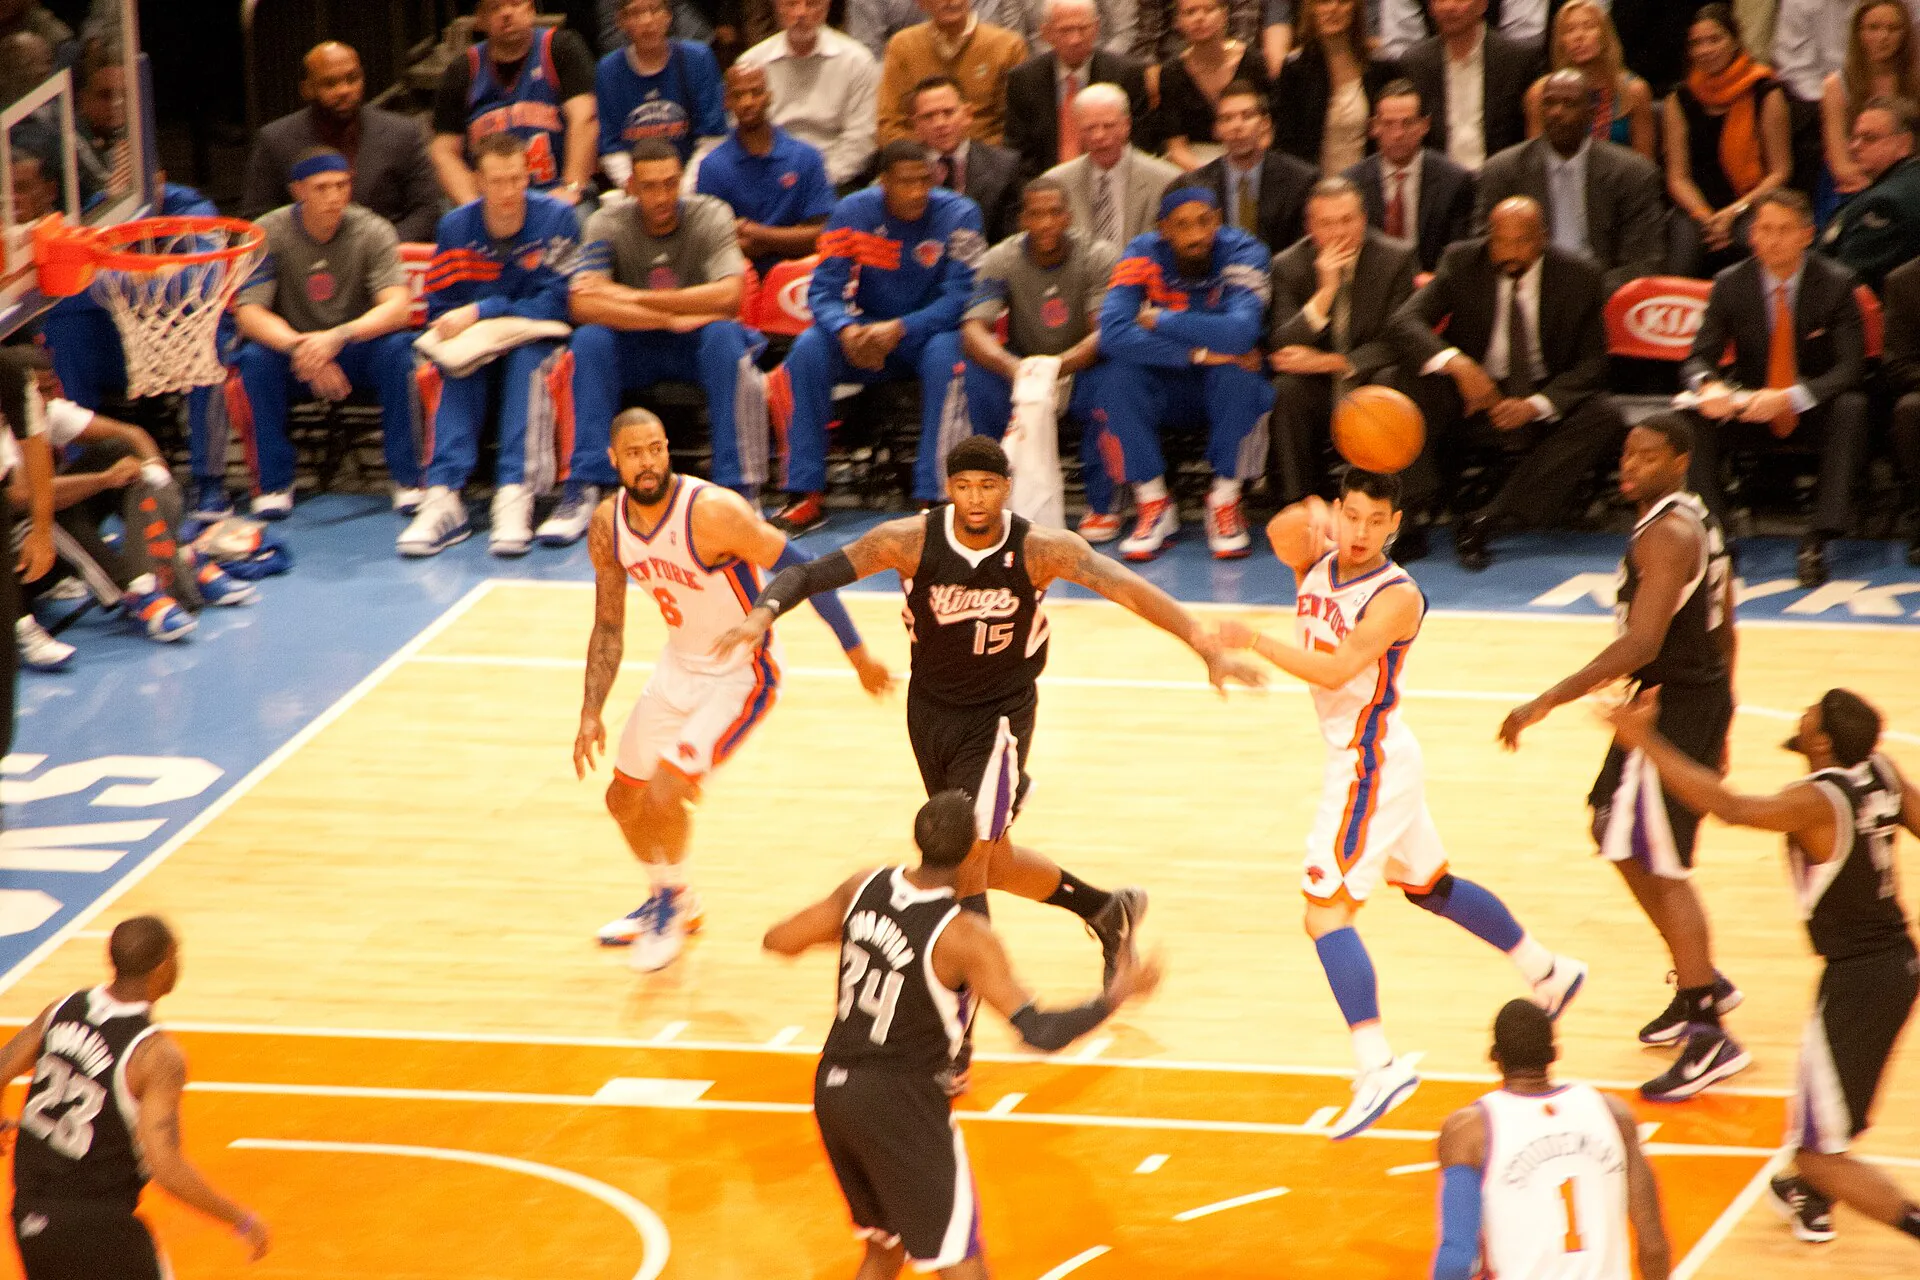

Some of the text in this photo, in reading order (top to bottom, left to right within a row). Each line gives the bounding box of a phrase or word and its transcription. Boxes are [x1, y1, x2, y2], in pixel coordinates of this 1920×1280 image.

[648, 557, 704, 591] YORK
[652, 587, 684, 630] 6
[929, 583, 1020, 625] Kings
[973, 620, 1015, 655] 15
[838, 941, 906, 1047] 34
[30, 1051, 108, 1161] 23
[1556, 1175, 1586, 1254] 1
